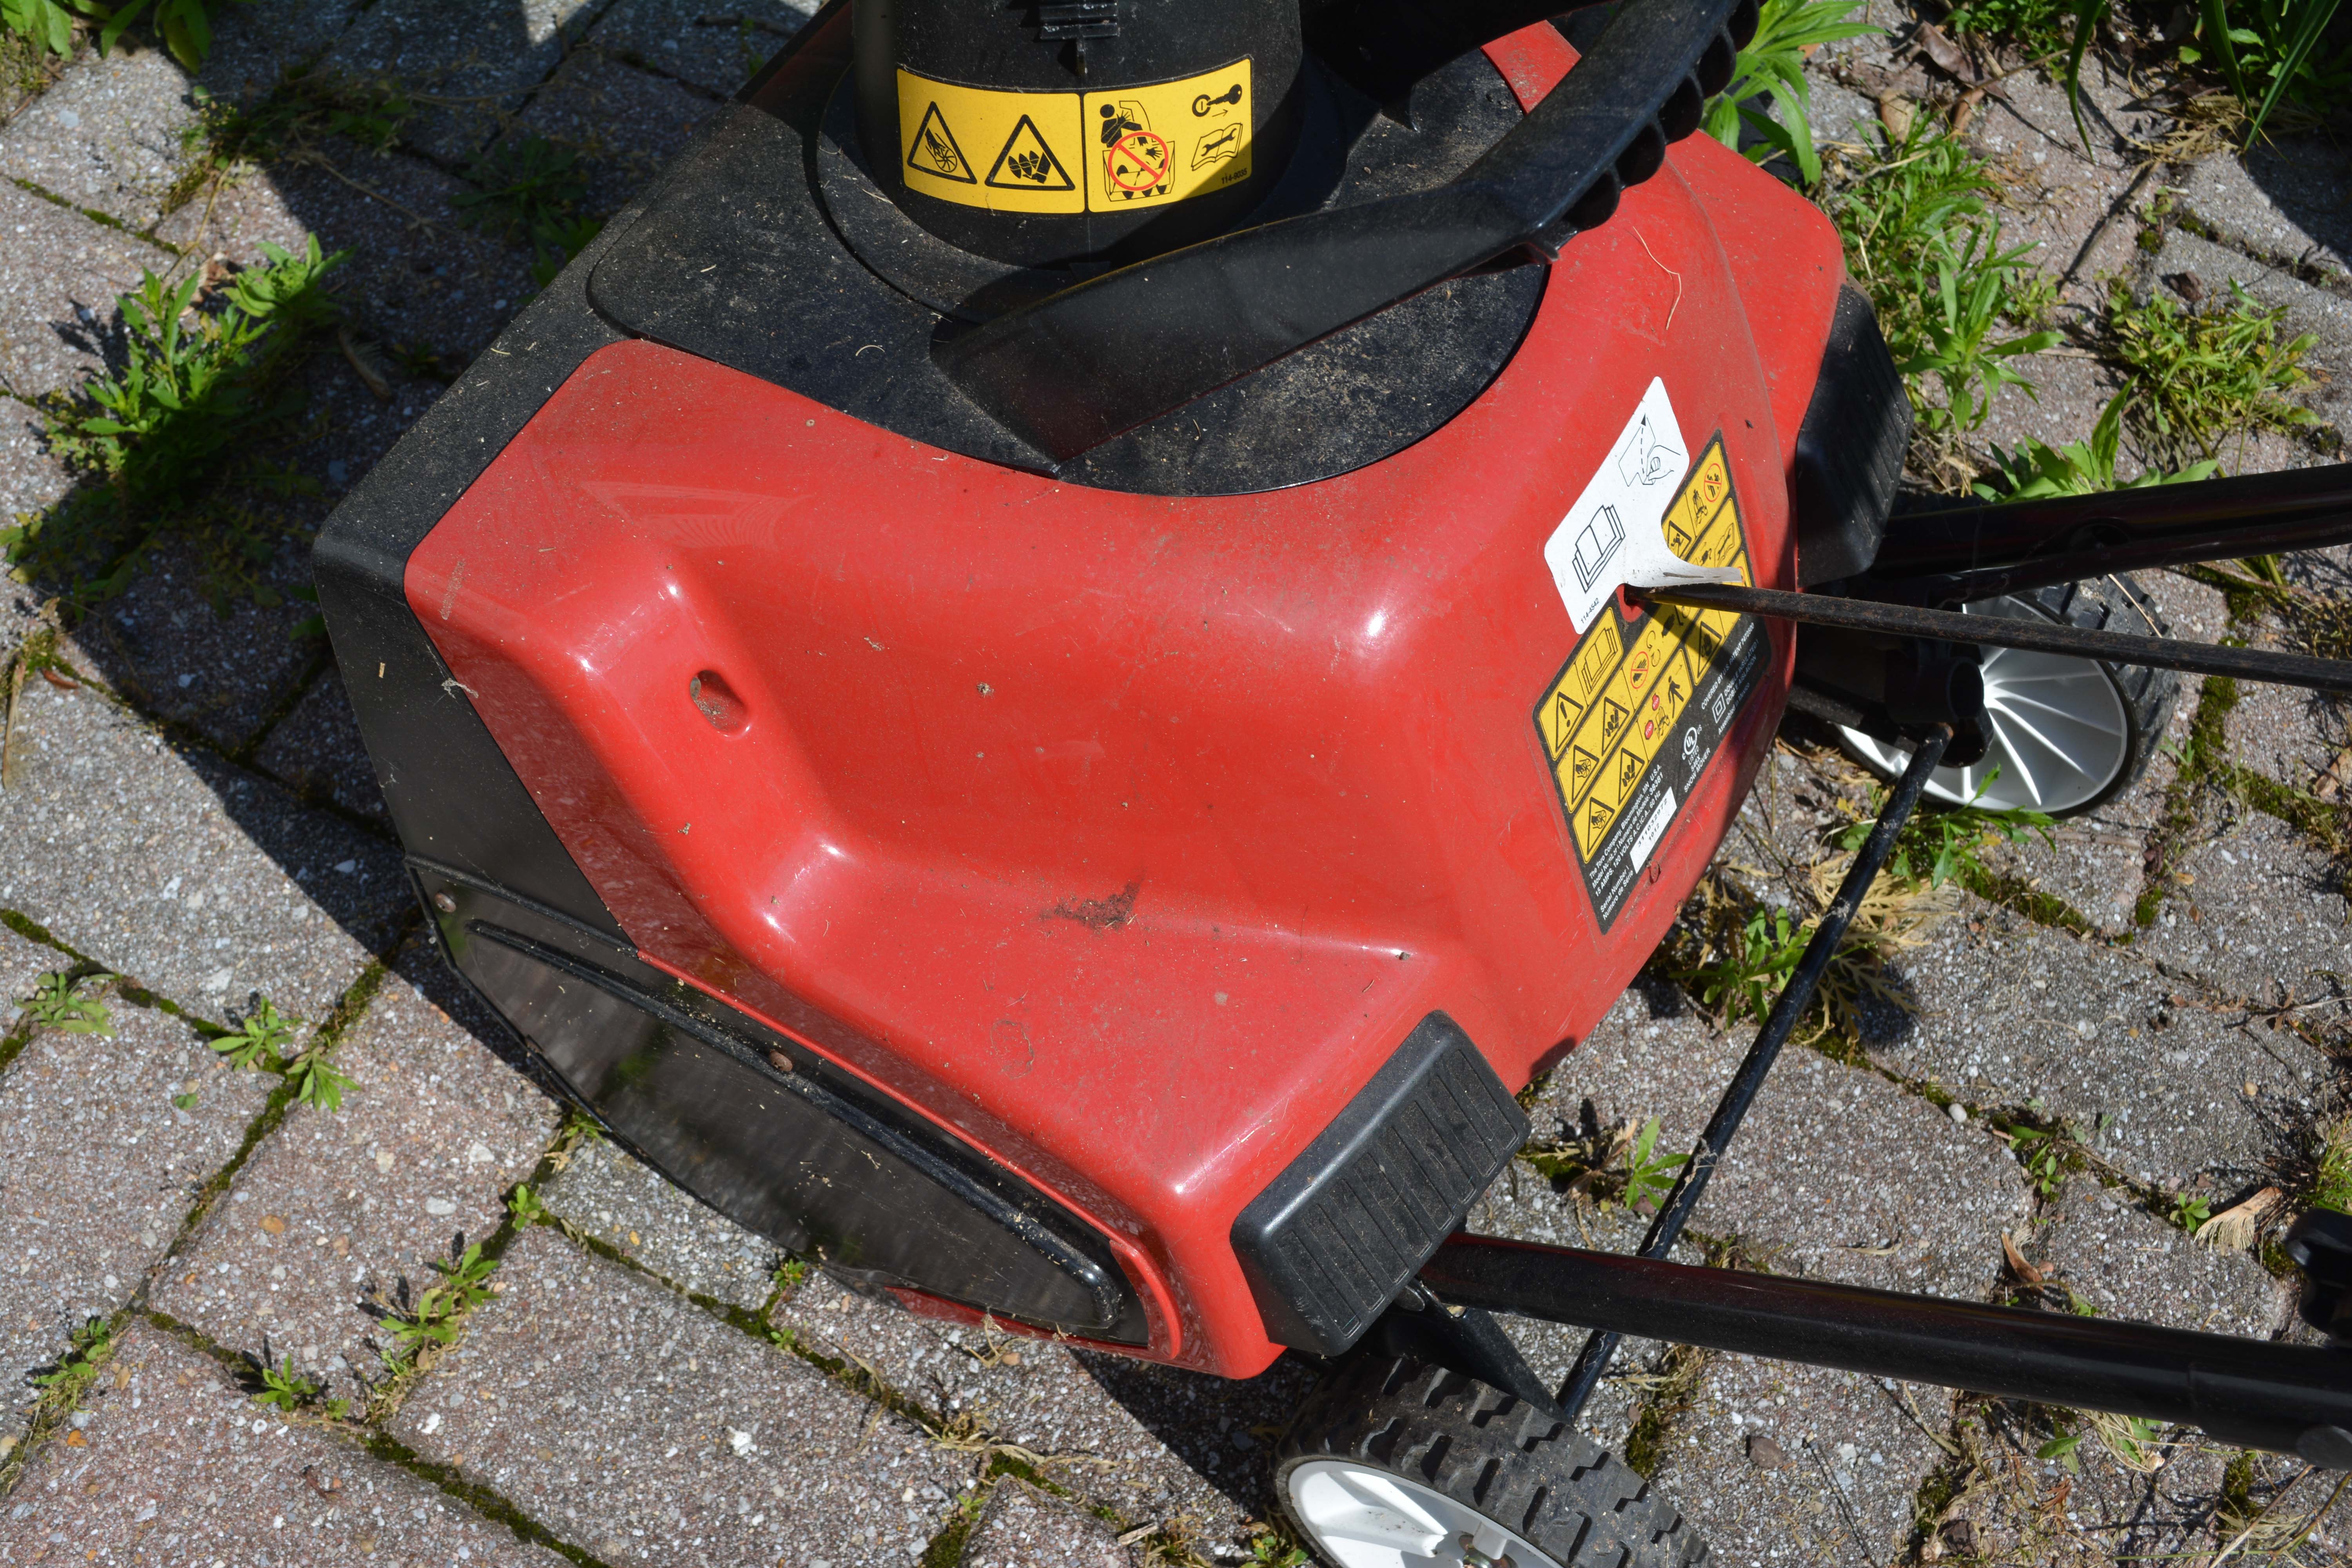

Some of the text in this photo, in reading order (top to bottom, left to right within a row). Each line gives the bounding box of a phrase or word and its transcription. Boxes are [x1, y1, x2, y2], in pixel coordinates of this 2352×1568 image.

[1221, 167, 1247, 184] 114-9035
[1581, 597, 1599, 624] 114-4542
[1702, 682, 1718, 710] COVERED
[1717, 674, 1722, 684] BY
[1729, 642, 1742, 665] PATENT
[1724, 671, 1739, 697] DOUBLE
[1726, 683, 1739, 705] DOBLE
[1697, 724, 1702, 734] US
[1719, 705, 1735, 735] Assembled
[1684, 748, 1710, 792] SNOW MOVER
[1688, 746, 1699, 765] LISTED
[1592, 869, 1604, 888] Model
[1618, 824, 1632, 846] Numero
[1632, 816, 1637, 824] de
[1650, 772, 1662, 795] 38381
[1596, 855, 1604, 868] Toro
[1642, 782, 1649, 794] MN
[1650, 764, 1661, 781] U.S.A.
[1596, 887, 1601, 896] 15
[1620, 835, 1633, 856] VOLTS
[1650, 799, 1655, 808] 60
[1654, 791, 1661, 800] Hz
[1649, 823, 1659, 840] 1012
[1601, 893, 1612, 912] Serial
[1612, 869, 1626, 895] Number
[1603, 895, 1618, 920] Numero
[1618, 887, 1623, 896] de
